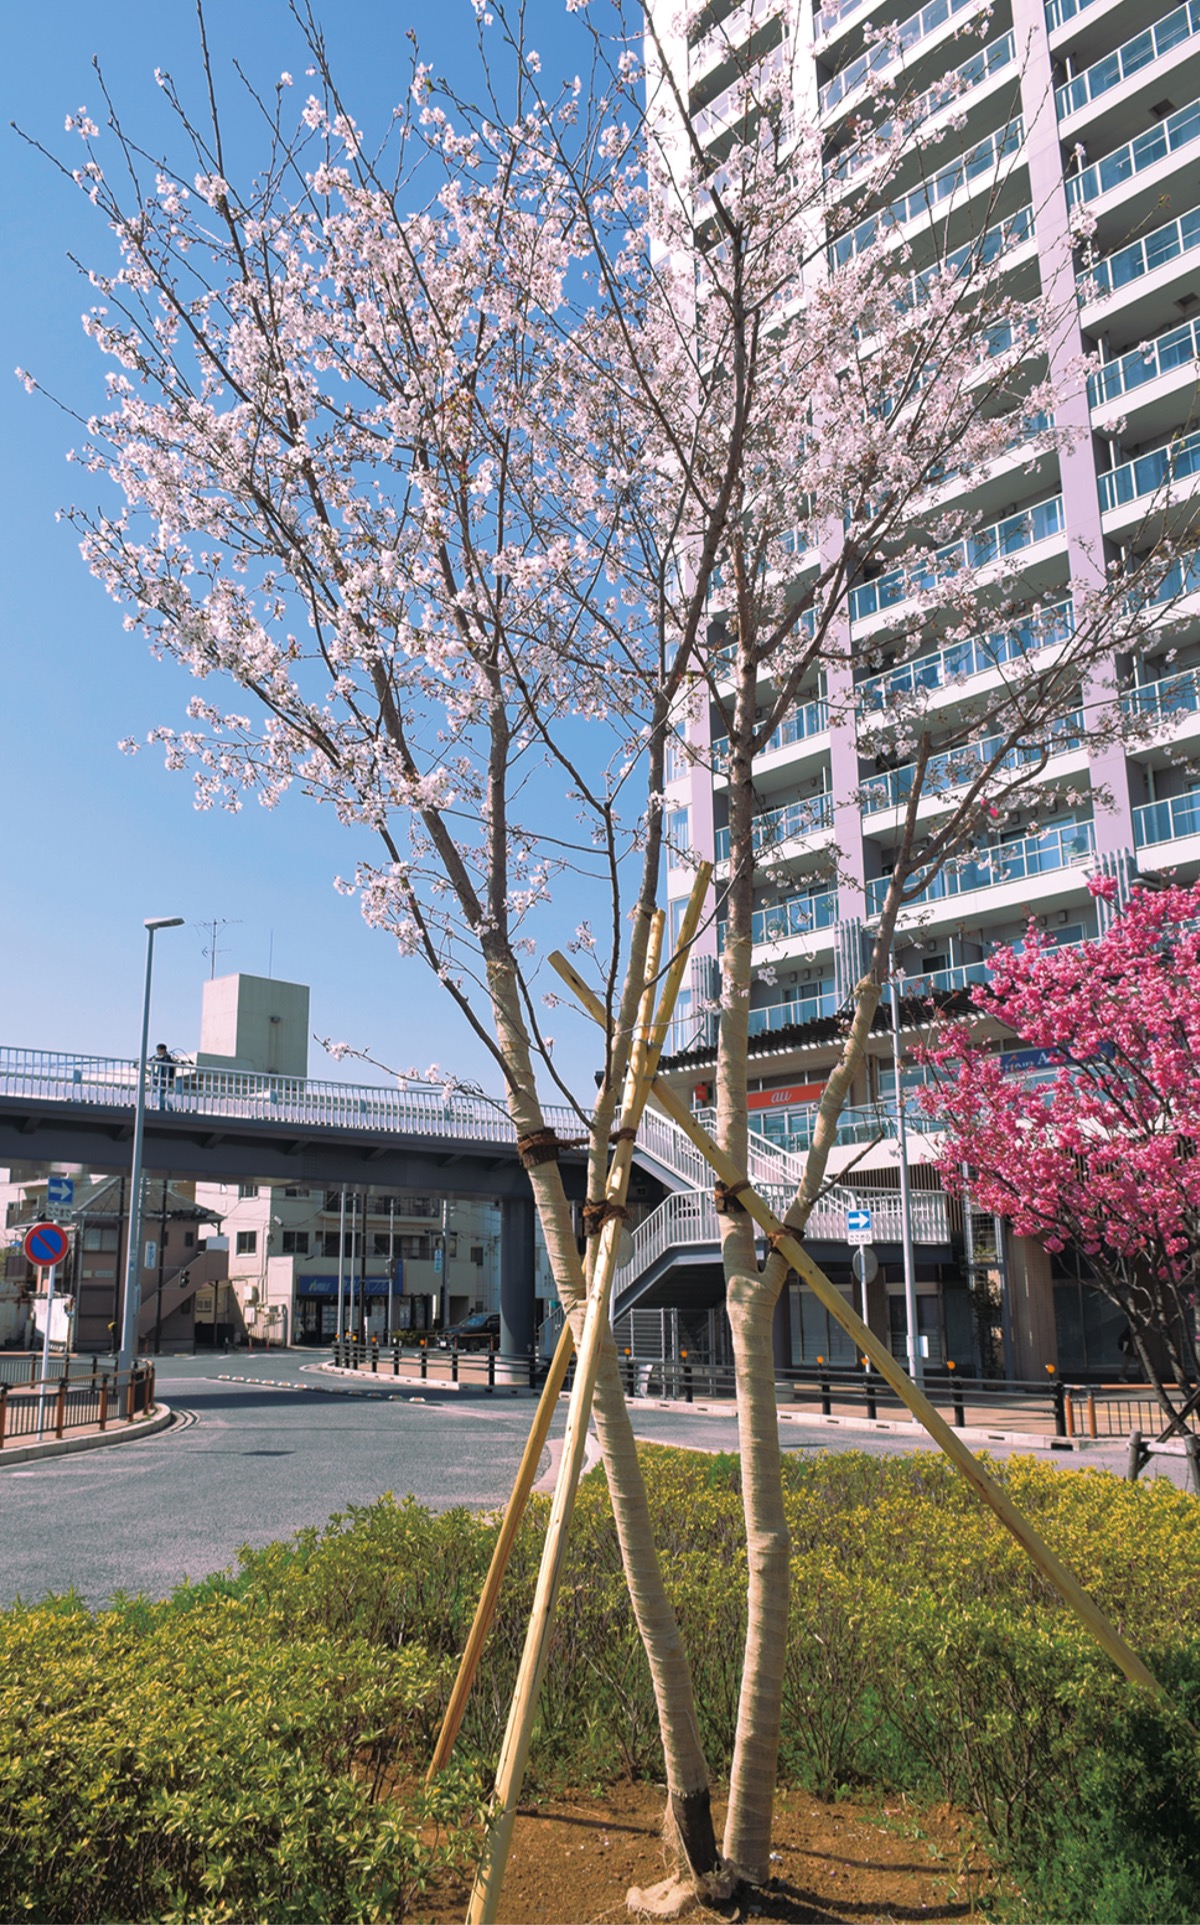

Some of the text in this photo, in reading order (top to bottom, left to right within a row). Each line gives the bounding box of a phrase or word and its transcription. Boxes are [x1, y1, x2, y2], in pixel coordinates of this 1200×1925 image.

[771, 1090, 792, 1104] au
[47, 1206, 71, 1218] ここまで
[849, 1233, 871, 1243] ここから
